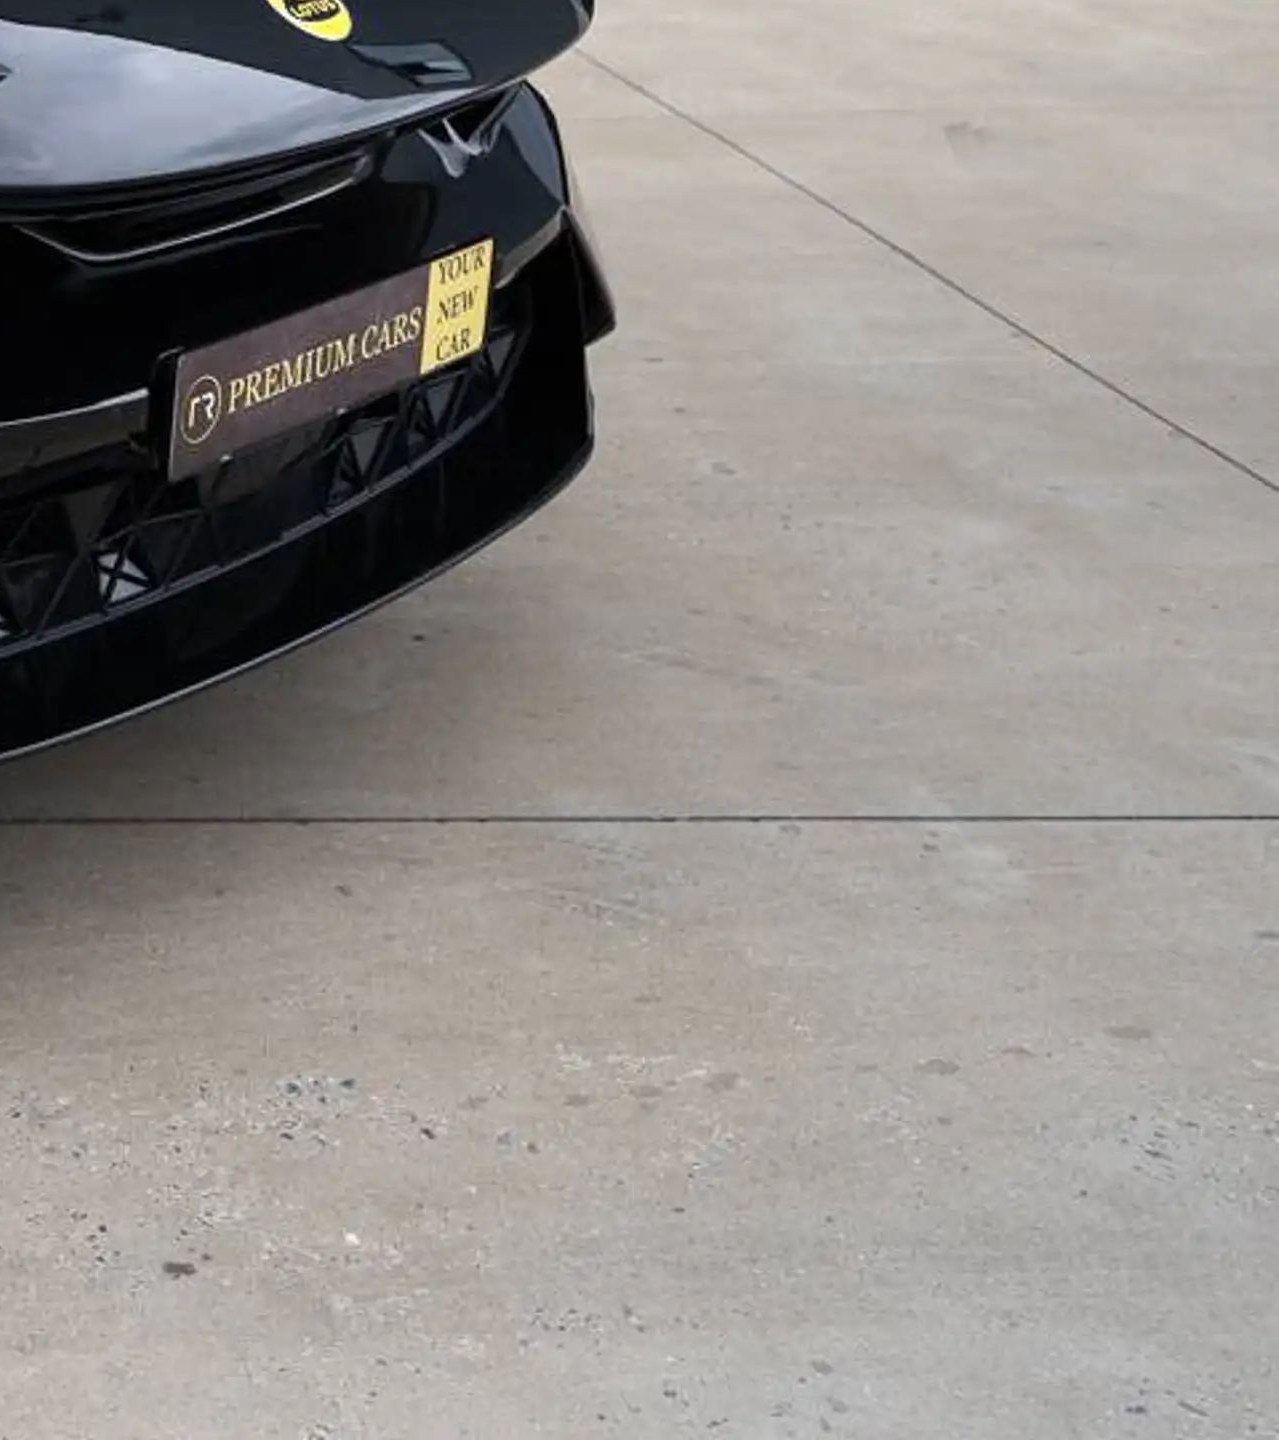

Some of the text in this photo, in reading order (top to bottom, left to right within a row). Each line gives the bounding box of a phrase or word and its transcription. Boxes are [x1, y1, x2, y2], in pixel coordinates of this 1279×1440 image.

[437, 243, 487, 286] YOUR
[436, 285, 480, 324] NEW
[226, 305, 425, 415] PREMIUM CARS
[435, 327, 472, 363] CAR
